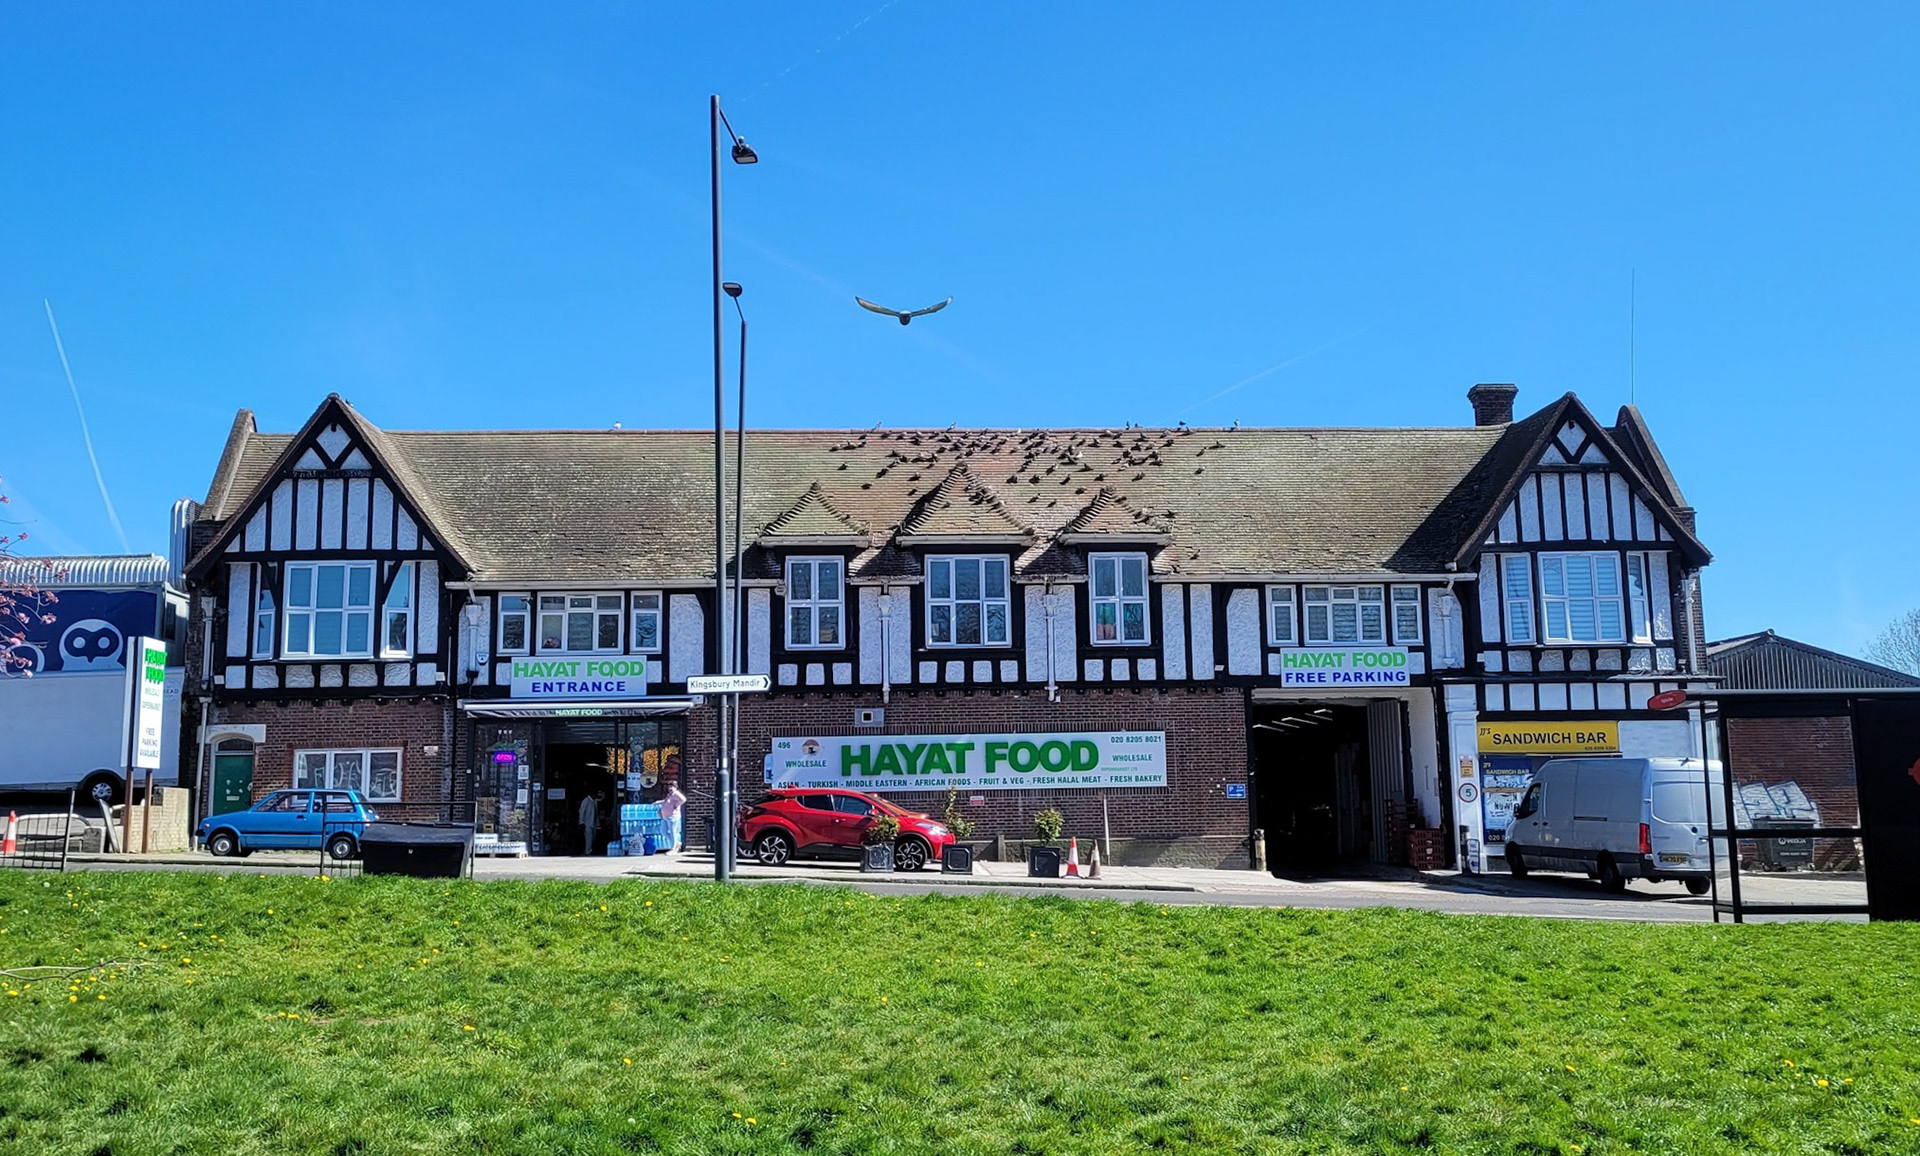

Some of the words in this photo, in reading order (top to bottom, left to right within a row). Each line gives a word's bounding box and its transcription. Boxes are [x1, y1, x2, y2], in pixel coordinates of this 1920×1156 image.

[1283, 652, 1346, 668] HAYAT
[1352, 652, 1406, 667] FOOD
[513, 661, 581, 678] HAYAT
[587, 661, 644, 677] FOOD
[1285, 672, 1327, 683] FREE
[1333, 671, 1406, 682] PARKING
[532, 681, 626, 693] ENTRANCE
[690, 680, 730, 689] Kingsbury
[733, 679, 760, 687] Mandir
[1111, 736, 1123, 744] 020
[1126, 736, 1143, 744] 8205
[1145, 735, 1162, 743] 8021
[1492, 733, 1571, 745] SANDWICH
[1576, 732, 1607, 744] BAR
[778, 742, 791, 750] 496
[785, 760, 827, 768] WHOLESALE
[841, 742, 975, 777] HAYAT
[985, 740, 1099, 774] FOOD
[1112, 754, 1152, 762] WHOLESALE
[875, 779, 908, 787] EASTERN
[948, 778, 971, 786] FOODS
[1002, 777, 1007, 785] &
[1057, 776, 1080, 784] HALAL
[1110, 775, 1133, 783] FRESH
[1466, 789, 1472, 797] 5
